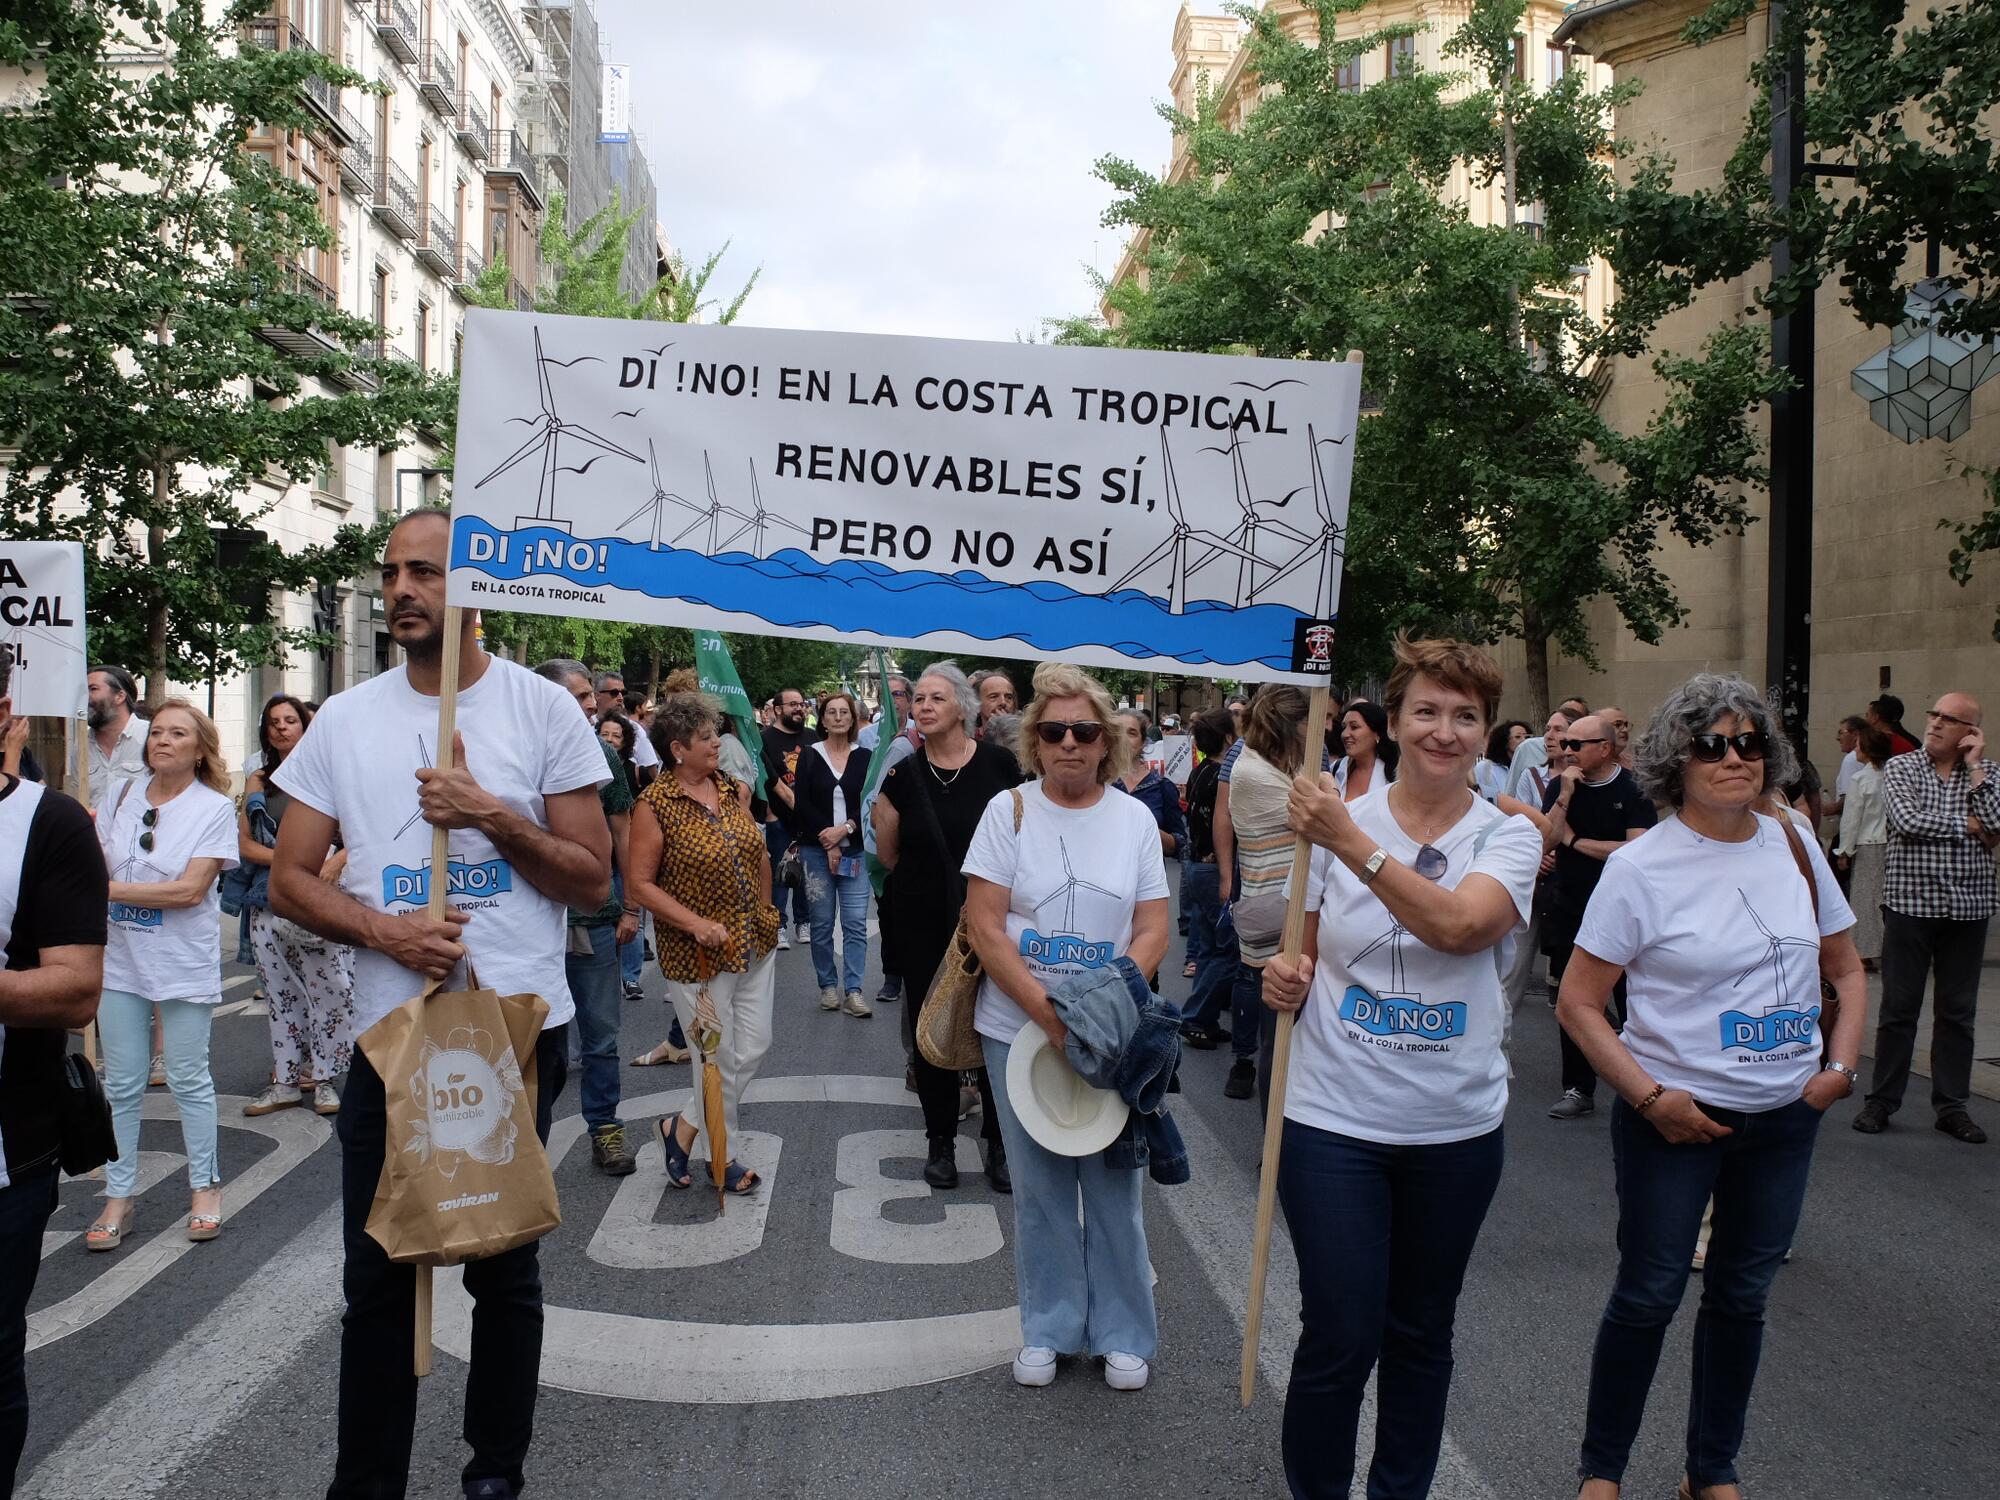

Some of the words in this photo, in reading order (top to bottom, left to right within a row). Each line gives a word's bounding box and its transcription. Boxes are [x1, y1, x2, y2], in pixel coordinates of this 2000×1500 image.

[676, 361, 759, 398] !NO!
[778, 367, 831, 402] EN
[848, 372, 899, 408] LA
[915, 376, 1053, 419] COSTA
[1072, 387, 1288, 435] TROPICAL
[775, 442, 1082, 501] RENOVABLES
[1100, 455, 1156, 513] SÍ,
[468, 532, 509, 564] DI
[522, 538, 609, 574] ¡NO!
[810, 517, 932, 561] PERO
[951, 529, 1015, 568] NO
[1032, 527, 1113, 576] ASÍ
[471, 581, 488, 593] EN
[490, 582, 506, 594] LA
[508, 584, 545, 598] COSTA
[548, 588, 606, 604] TROPICAL
[394, 873, 424, 897] DI
[456, 899, 500, 912] TROPICAL
[128, 926, 155, 934] TROPICAL
[1028, 939, 1051, 958] DI
[1058, 941, 1107, 965] ¡NO!
[1048, 966, 1069, 976] COSTA
[1351, 999, 1382, 1026] DI
[1387, 1004, 1454, 1034] ¡NO!
[1348, 1030, 1360, 1041] EN
[1361, 1034, 1374, 1045] LA
[1375, 1037, 1404, 1052] COSTA
[1406, 1043, 1450, 1053] TROPICAL
[1735, 1022, 1765, 1043] DI
[1738, 1055, 1751, 1064] EN
[1752, 1054, 1764, 1063] LA
[1765, 1052, 1789, 1062] COSTA
[432, 1072, 484, 1112] bio
